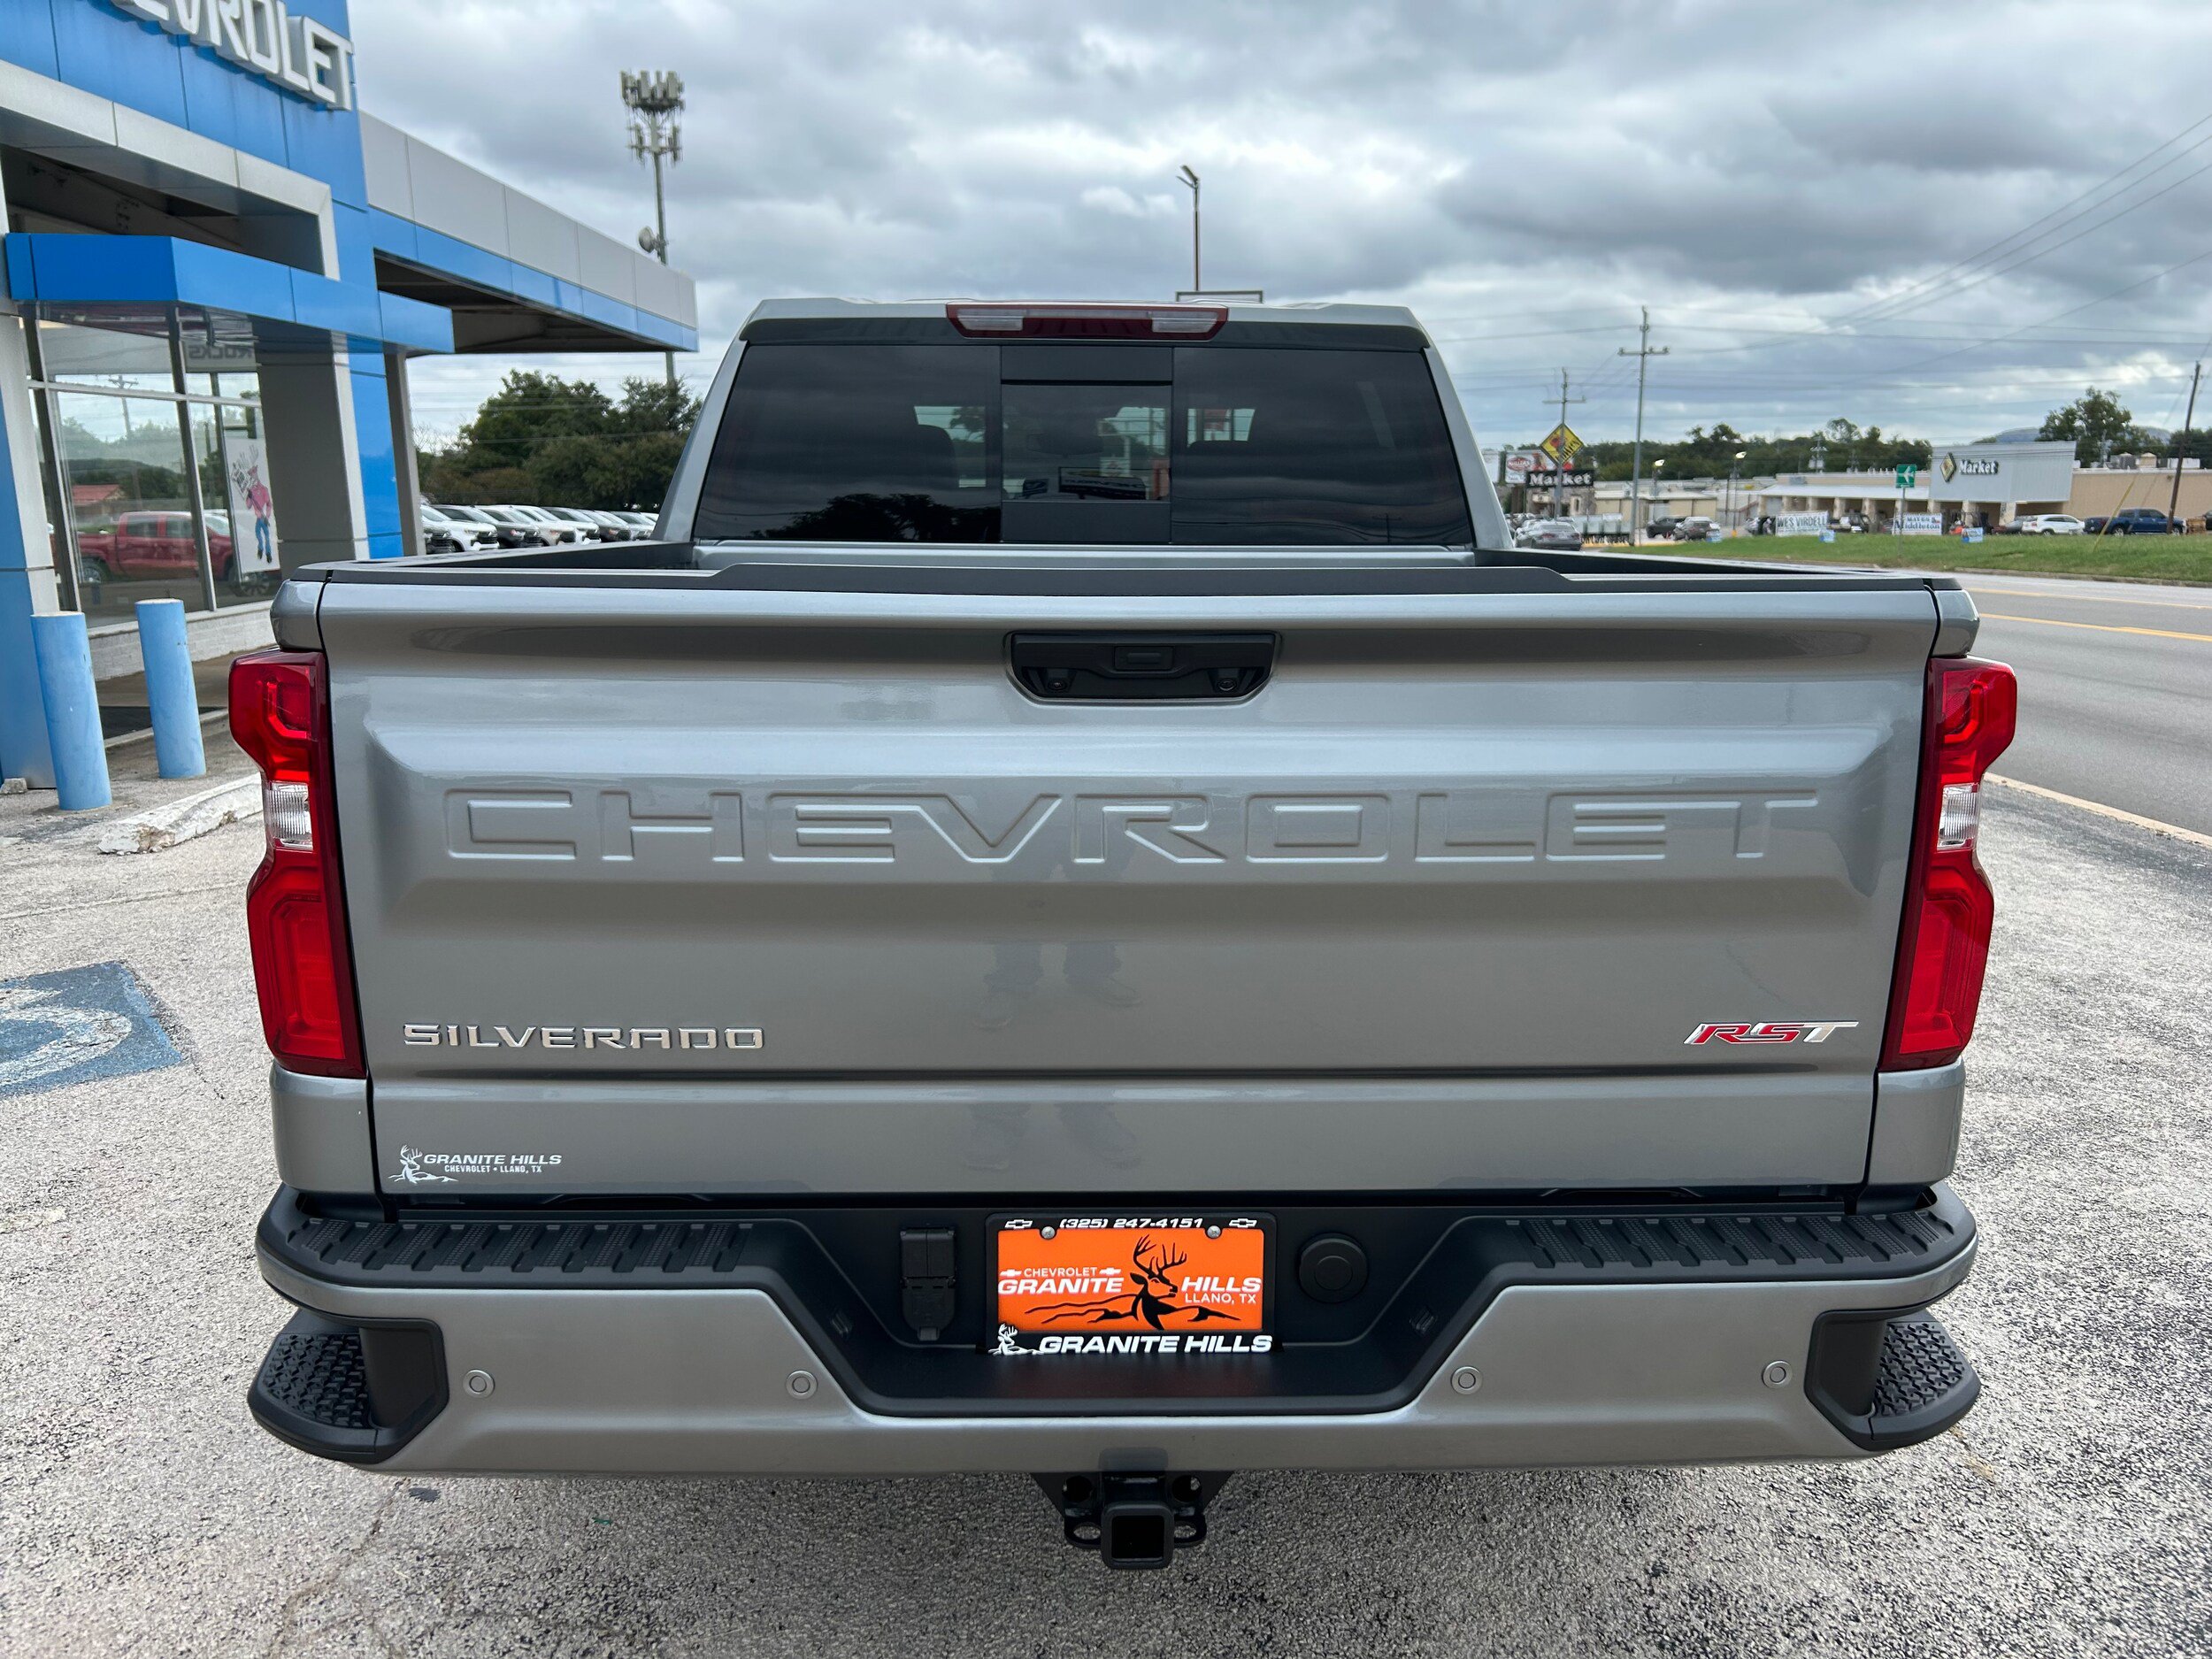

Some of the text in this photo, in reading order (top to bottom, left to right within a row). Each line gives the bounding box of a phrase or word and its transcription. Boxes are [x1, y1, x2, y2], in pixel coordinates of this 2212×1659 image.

[1959, 458, 1999, 475] Market
[1777, 515, 1826, 527] WES VIRDELL
[444, 787, 1819, 865] CHEVROLET
[403, 1023, 764, 1050] SILVERADO
[1684, 1020, 1859, 1044] RST
[423, 1154, 562, 1164] GRANITE HILLS
[1059, 1217, 1202, 1229] (325) 247-4151
[1024, 1267, 1096, 1277] CHEVROLET
[998, 1277, 1263, 1294] GRANITE HILLS
[1185, 1293, 1256, 1305] LLANO, TX
[1039, 1334, 1272, 1354] GRANITE HILLS
